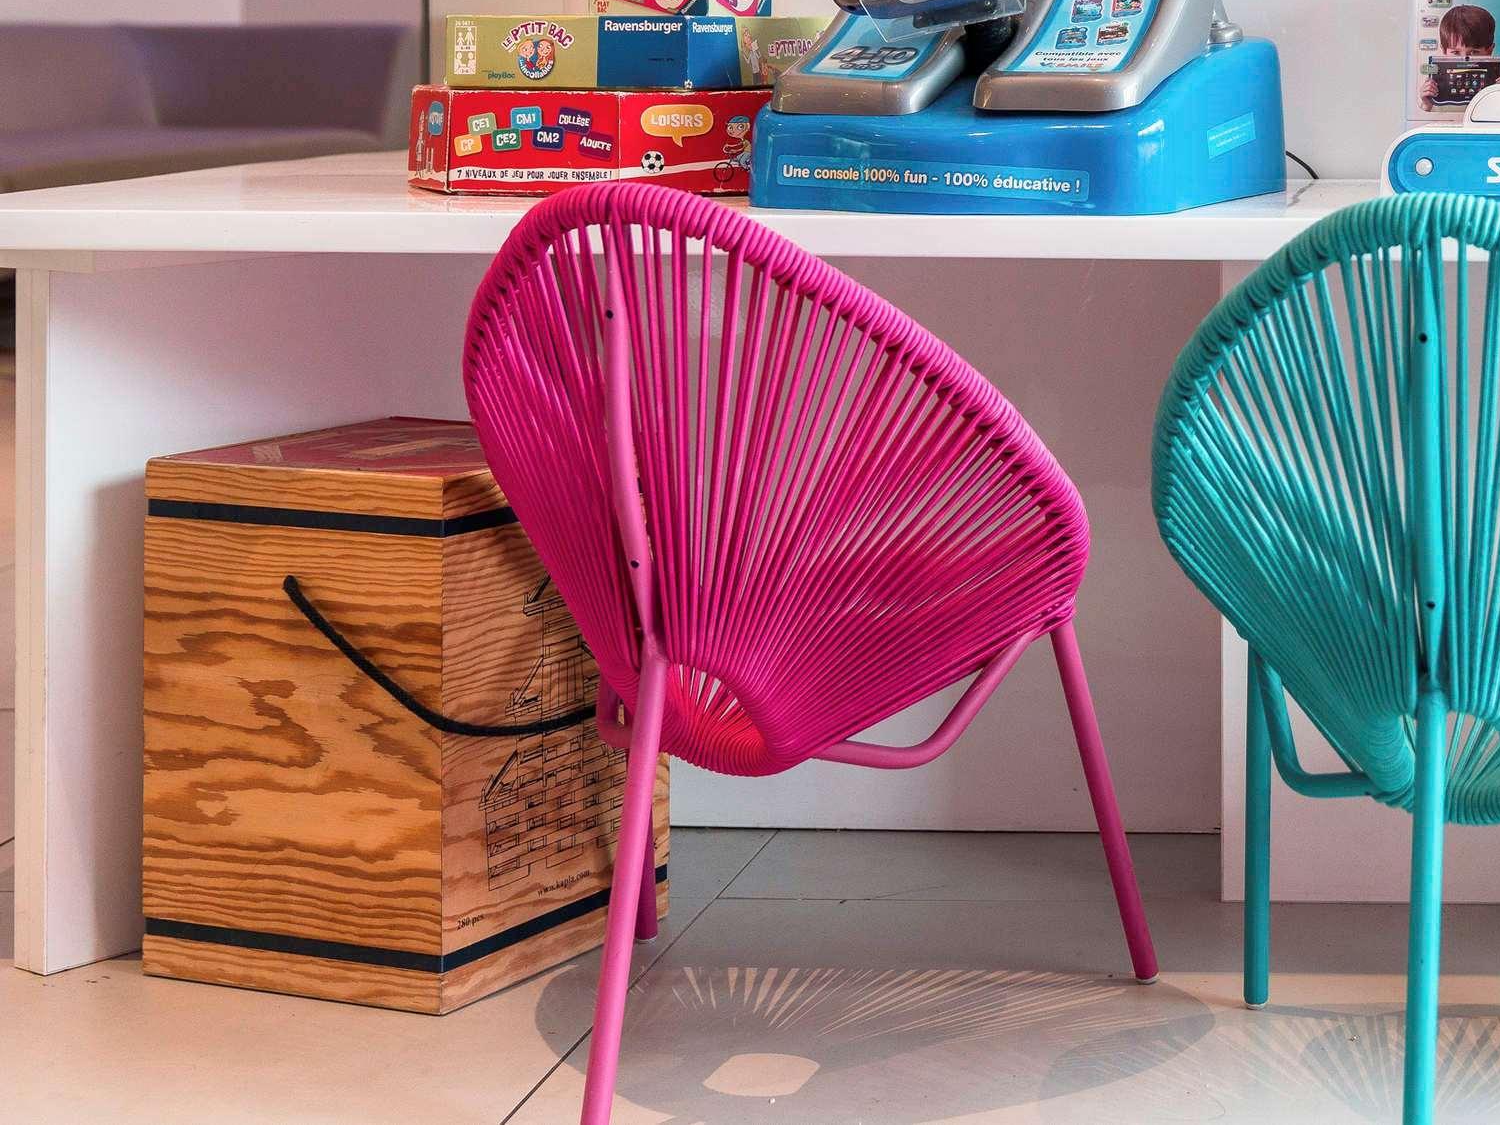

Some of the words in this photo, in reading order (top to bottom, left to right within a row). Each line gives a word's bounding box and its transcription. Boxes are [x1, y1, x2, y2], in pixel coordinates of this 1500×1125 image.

[604, 20, 682, 34] Ravensburger
[692, 22, 734, 35] Ravensburger
[548, 24, 573, 46] BAC
[516, 112, 537, 125] CM1
[651, 113, 703, 127] LOISIRS
[473, 118, 490, 133] CE1
[496, 133, 517, 146] CE2
[536, 131, 560, 144] CM2
[580, 136, 612, 151] ADULTE
[457, 169, 462, 179] 7
[465, 168, 497, 179] NIVEAUX
[500, 169, 510, 179] DE
[512, 170, 524, 180] JEU
[527, 169, 544, 180] POUR
[548, 170, 569, 179] JOUER
[783, 164, 810, 178] Une
[814, 167, 859, 181] console
[863, 167, 900, 183] 100%
[903, 170, 927, 184] fun
[944, 172, 988, 188] 100%
[993, 174, 1071, 193] éducative
[456, 918, 471, 930] 280
